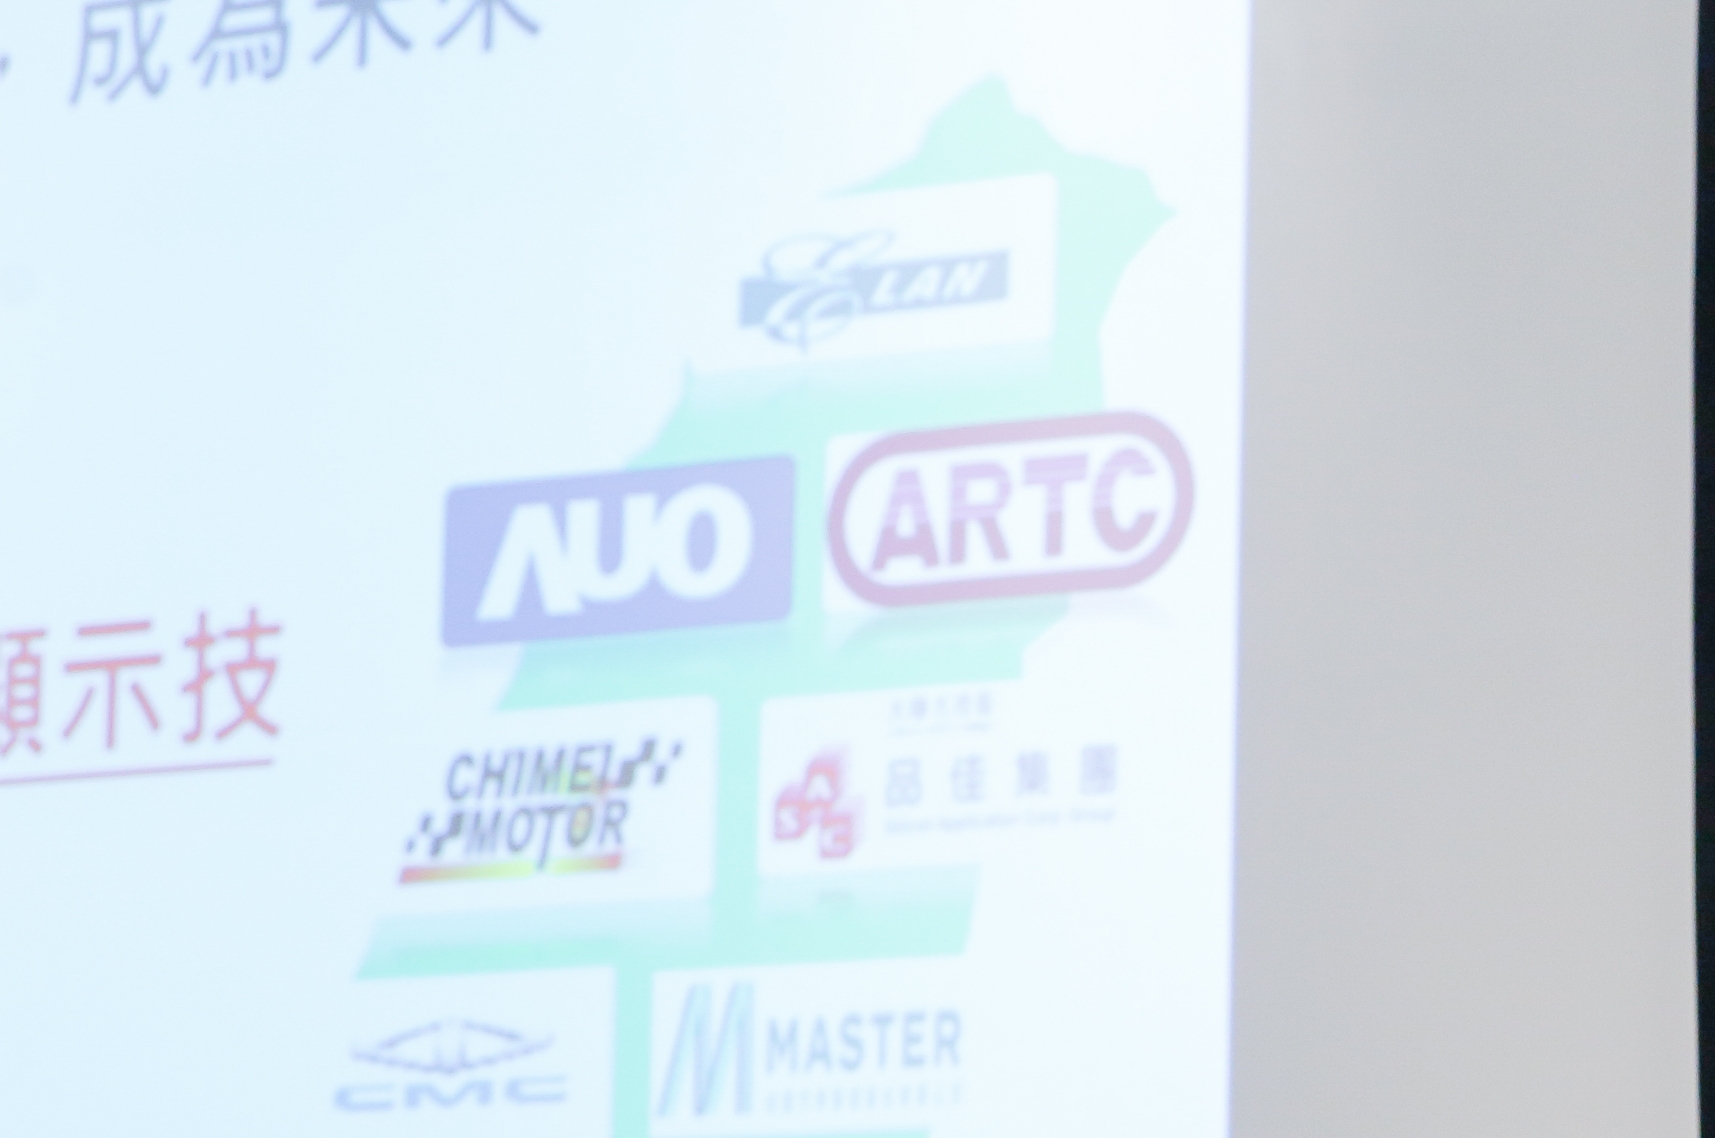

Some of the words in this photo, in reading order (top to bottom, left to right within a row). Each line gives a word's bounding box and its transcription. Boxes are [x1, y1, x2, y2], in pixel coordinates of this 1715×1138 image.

[871, 446, 1161, 573] ARTC
[475, 482, 755, 624] AUO
[463, 798, 628, 870] MOTOR
[764, 1008, 965, 1075] MASTER
[333, 1072, 570, 1113] CMC
